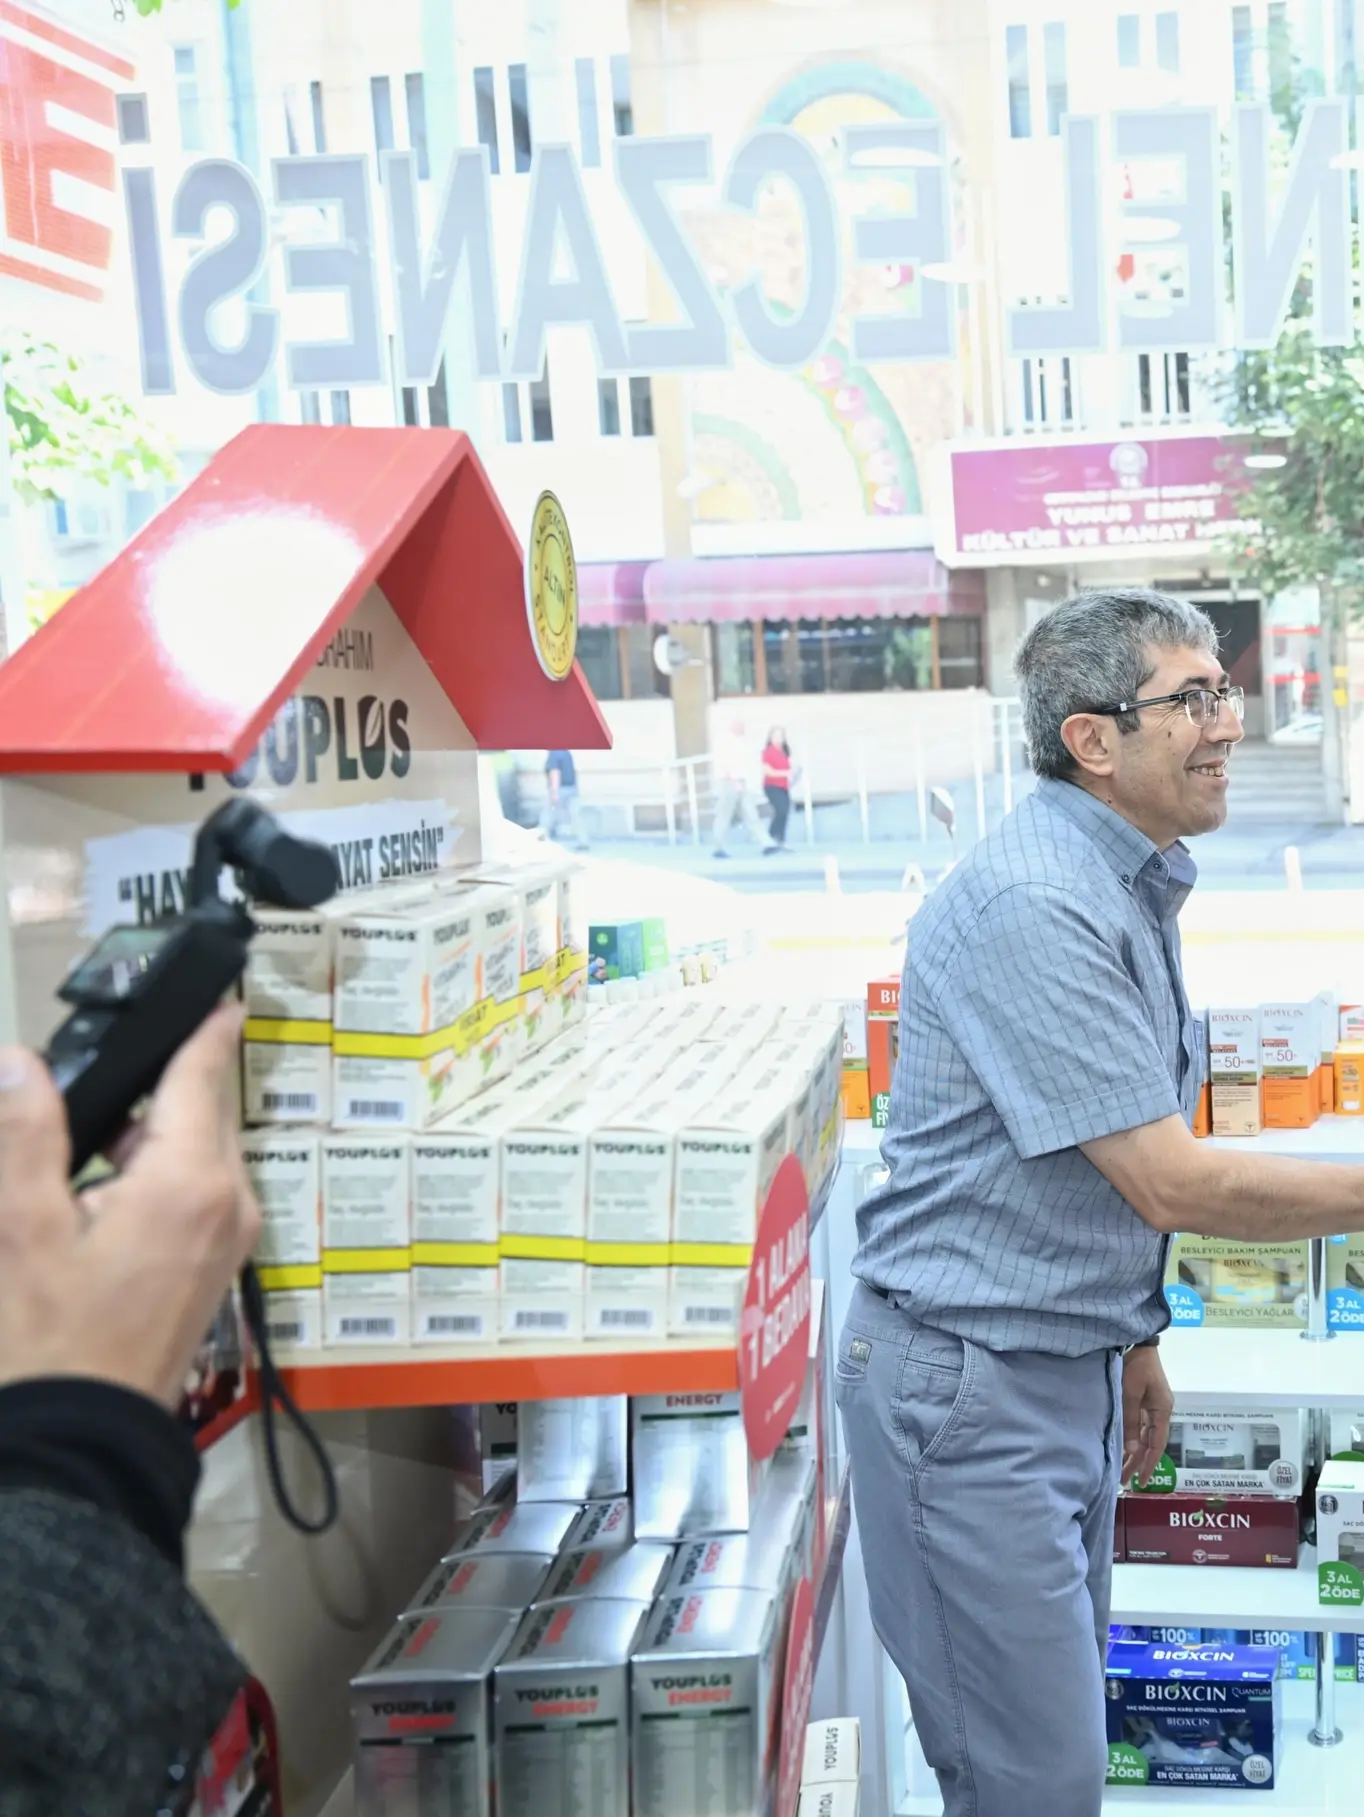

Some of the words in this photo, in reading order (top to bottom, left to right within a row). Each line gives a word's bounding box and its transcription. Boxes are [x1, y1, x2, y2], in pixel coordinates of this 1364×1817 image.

[256, 923, 323, 936] OUPLUS
[242, 1150, 311, 1162] OUPLUS
[1179, 1295, 1194, 1306] AL
[1336, 1297, 1345, 1309] 3
[1346, 1300, 1361, 1310] AL
[666, 1393, 722, 1408] ENERGY
[1212, 1479, 1236, 1488] SATAN
[1169, 1509, 1250, 1529] BIOXCIN
[1198, 1534, 1222, 1542] FORTE
[1327, 1570, 1336, 1583] 3
[1337, 1575, 1353, 1584] AL
[1152, 1650, 1235, 1662] BIOXCIN
[651, 1674, 733, 1691] YOUPLUS
[515, 1685, 599, 1703] YOUPLUS
[668, 1689, 733, 1707] ENERGY
[1145, 1682, 1227, 1702] BIOXCIN
[1232, 1687, 1271, 1698] QUANTUM
[371, 1701, 456, 1716] YOUPLUS
[824, 1726, 839, 1772] YOUPLUS
[1112, 1752, 1120, 1764] 3
[1123, 1756, 1138, 1765] AL
[1156, 1771, 1168, 1779] EN
[1169, 1772, 1184, 1781] ÇOK
[1185, 1772, 1209, 1781] SATAN
